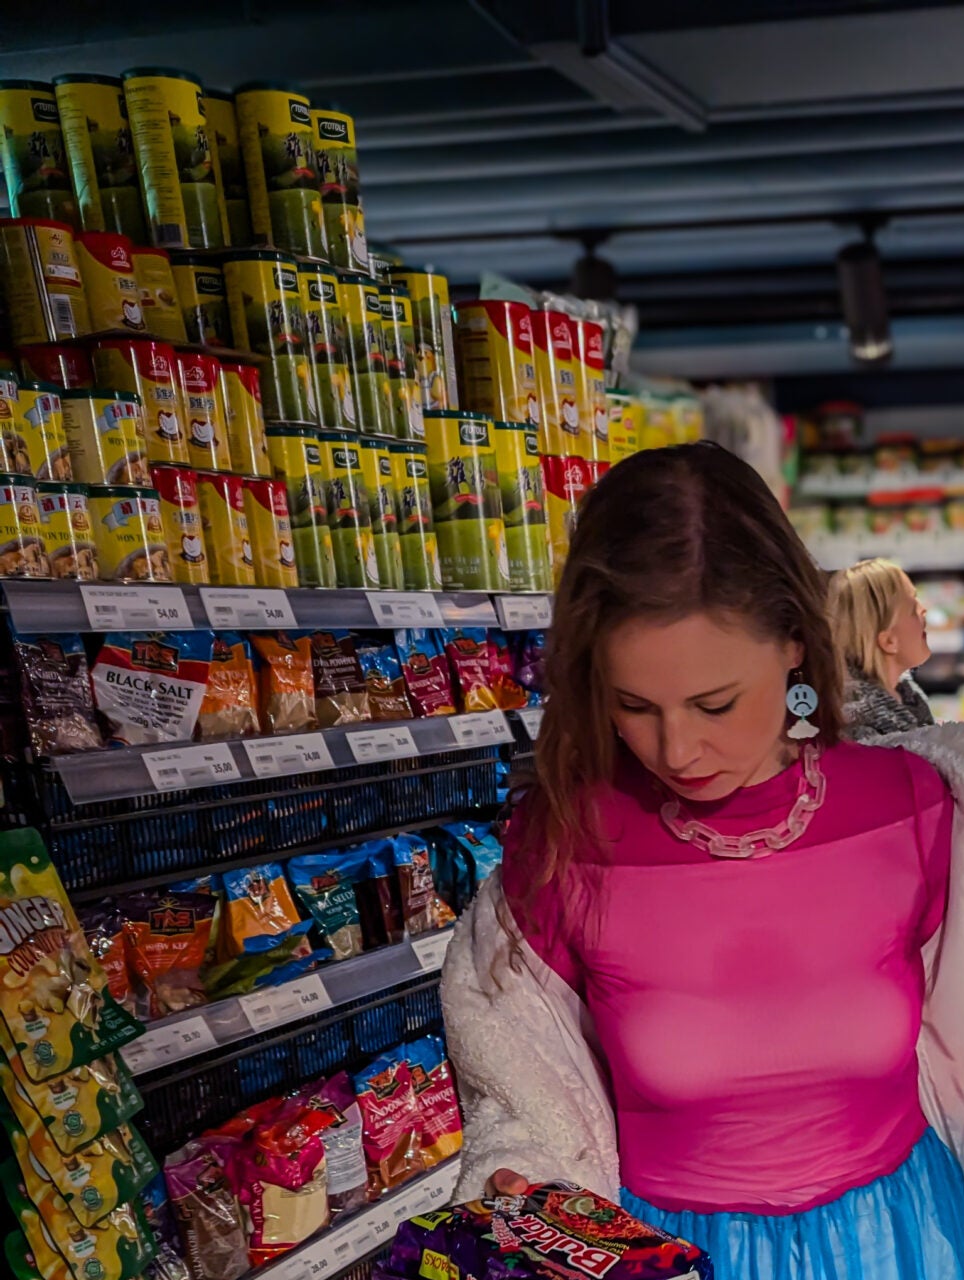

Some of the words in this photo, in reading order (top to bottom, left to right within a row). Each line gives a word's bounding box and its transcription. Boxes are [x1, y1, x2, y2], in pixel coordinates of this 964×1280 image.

[323, 120, 346, 132] TOTOLE
[464, 422, 488, 436] TOTOLE
[157, 608, 179, 619] 54,00
[266, 608, 285, 619] 54,00
[106, 670, 154, 692] BLACK
[158, 681, 193, 700] SALT
[212, 761, 233, 774] 35,00
[510, 1213, 621, 1280] Buldak
